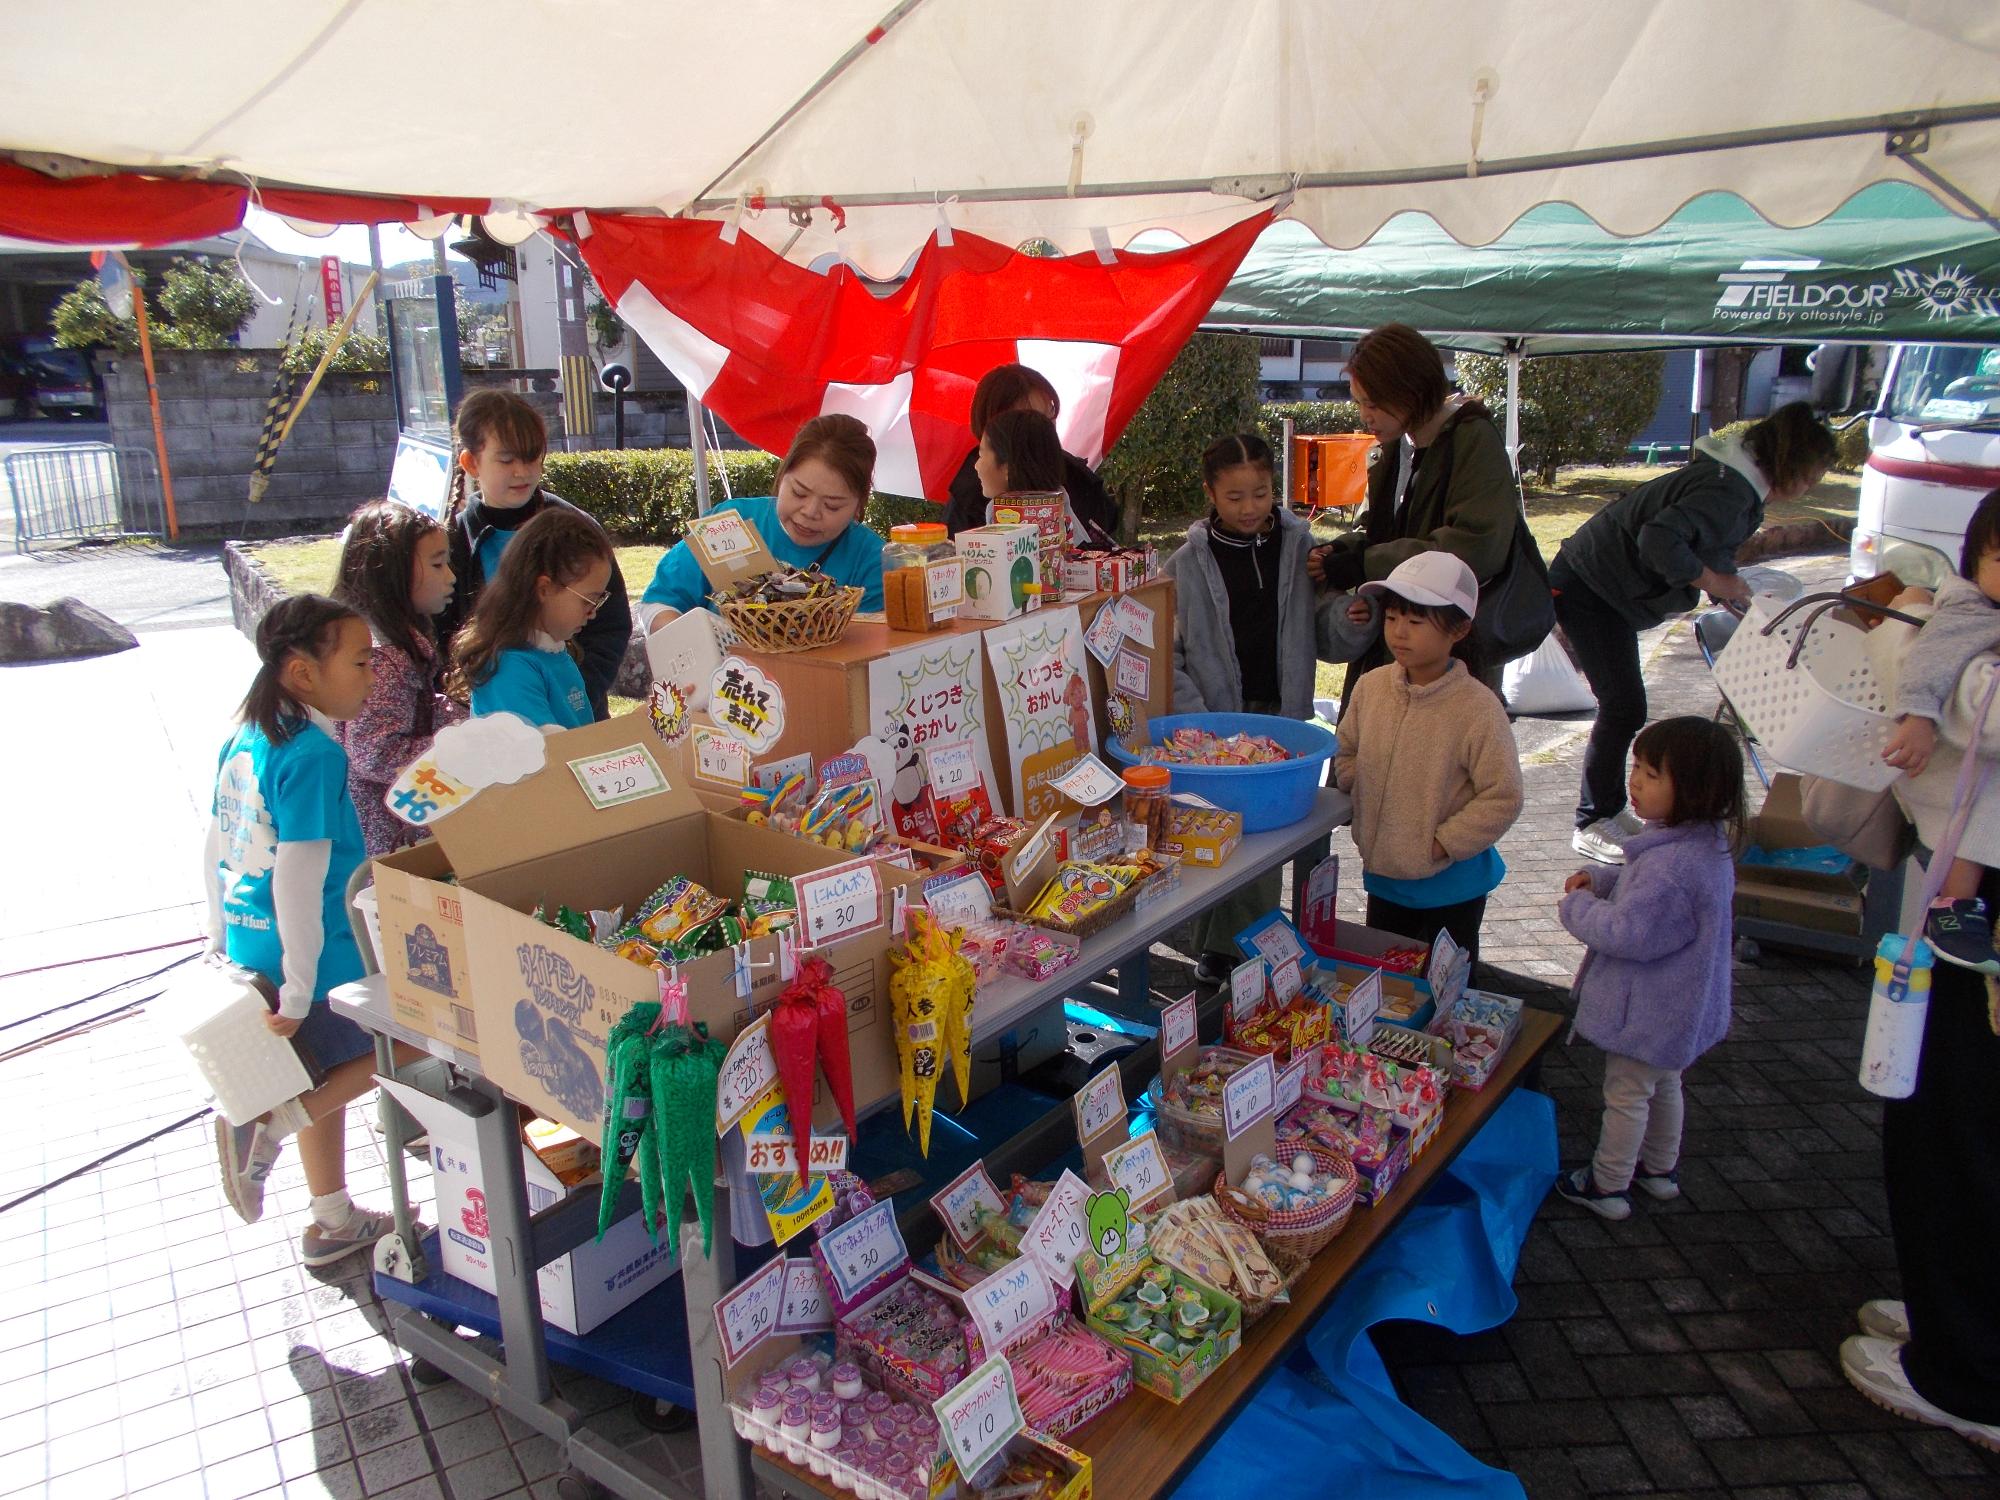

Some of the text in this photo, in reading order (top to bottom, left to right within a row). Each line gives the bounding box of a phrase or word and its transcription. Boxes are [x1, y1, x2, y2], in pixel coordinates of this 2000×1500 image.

[1751, 284, 1889, 307] FIELDOOR
[1713, 307, 1884, 324] Powered by ottostyle.jp
[1016, 660, 1064, 689] くじつき
[719, 668, 771, 713] 売れて
[905, 683, 963, 718] くじつき
[1026, 688, 1062, 714] おかし
[913, 714, 957, 744] おかし
[588, 754, 646, 776] キャベツ太郎
[716, 758, 727, 771] 10
[950, 769, 963, 783] 20
[614, 776, 637, 795] 20
[1084, 785, 1097, 797] 10
[813, 871, 871, 904] にんじんポン
[835, 904, 855, 928] 30
[409, 943, 448, 968] プレミアム
[740, 1067, 757, 1093] 20
[1096, 1103, 1109, 1123] 30
[1247, 1095, 1257, 1113] 10
[750, 1139, 844, 1169] おすめ!!
[1136, 1166, 1151, 1189] 30
[1068, 1221, 1081, 1246] 10
[861, 1247, 879, 1270] 30
[985, 1269, 1029, 1307] ほしうめ
[751, 1306, 768, 1332] 30
[800, 1297, 820, 1318] 30
[1014, 1300, 1028, 1323] 10
[1069, 1385, 1115, 1426] ほしうめ
[978, 1413, 994, 1442] 10
